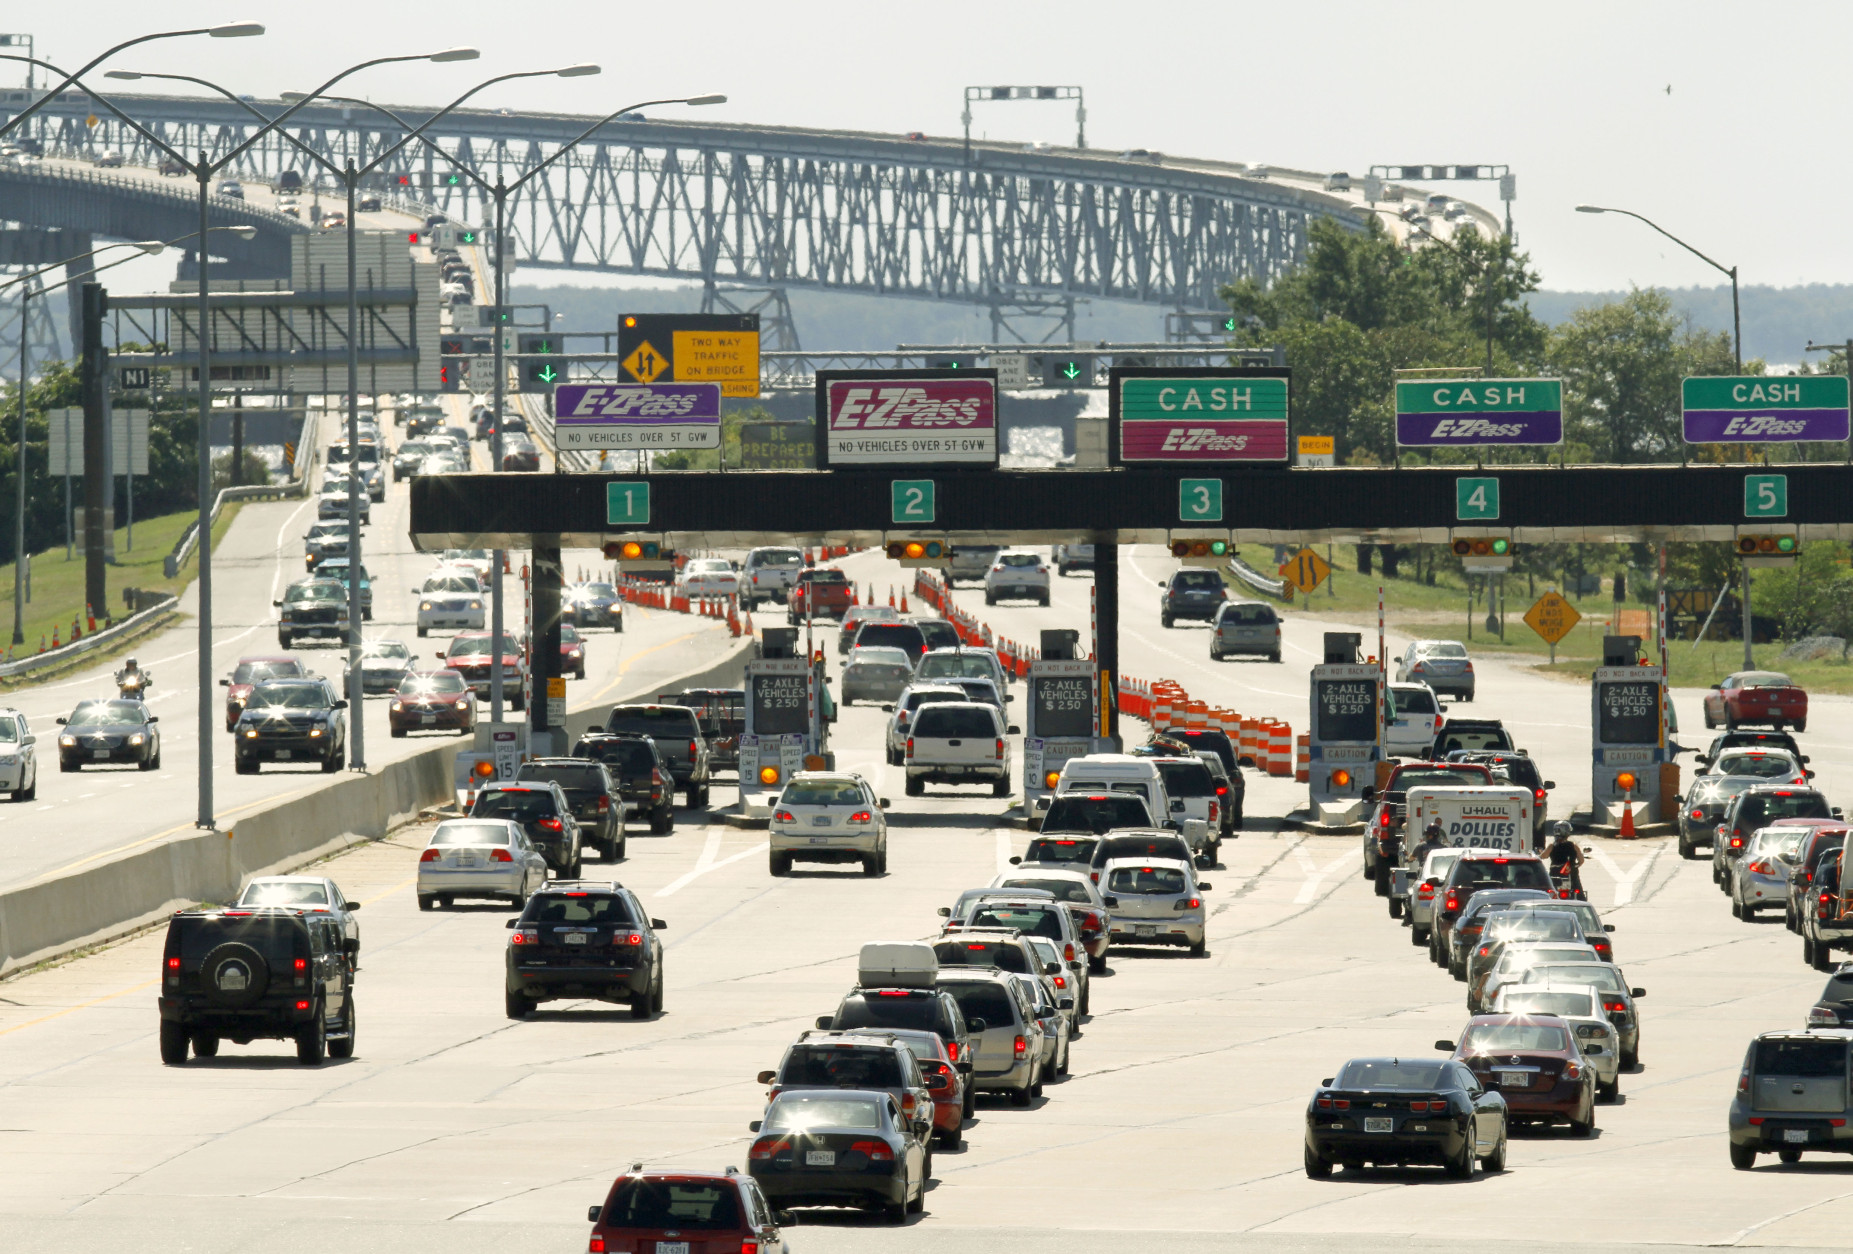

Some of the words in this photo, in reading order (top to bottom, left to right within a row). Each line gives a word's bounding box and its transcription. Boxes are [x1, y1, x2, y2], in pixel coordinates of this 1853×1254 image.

[691, 338, 712, 346] TWO
[719, 338, 741, 346] WAY
[694, 352, 738, 360] TRAFFIC
[687, 366, 701, 375] ON
[707, 365, 745, 375] BRIDGE
[721, 384, 754, 393] ASHING
[1732, 383, 1800, 402] CASH
[1158, 387, 1251, 411] CASH
[1433, 387, 1525, 406] CASH
[569, 433, 581, 443] NO
[588, 433, 633, 443] VEHICLES
[640, 432, 664, 442] OVER
[671, 432, 681, 442] 5T
[688, 432, 707, 442] GVW
[770, 426, 787, 441] BE
[743, 442, 814, 457] PREPARED
[839, 441, 853, 452] NO
[857, 441, 908, 452] VEHICLES
[912, 440, 940, 451] OVER
[944, 440, 957, 450] 5T
[962, 440, 985, 450] GVW
[904, 488, 924, 514] 2
[1191, 486, 1211, 514] 3
[1467, 485, 1487, 512] 4
[1758, 483, 1776, 510] 5
[624, 490, 633, 516] 1
[762, 678, 800, 688] 2-AXLE
[1043, 681, 1083, 690] 2-AXLE
[757, 688, 806, 698] VEHICLES
[1327, 684, 1366, 694] 2-AXLE
[1608, 686, 1648, 696] 2-AXLE
[1040, 690, 1088, 700] VEHICLES
[1322, 694, 1371, 704] VEHICLES
[776, 698, 799, 707] 2.50
[1058, 700, 1081, 710] 2.50
[1604, 696, 1653, 706] VEHICLES
[1340, 704, 1364, 714] 2.50
[1623, 706, 1647, 716] 2.50
[741, 748, 756, 757] SPEED
[782, 748, 800, 757] SPEED
[1046, 746, 1083, 754] CAUTION
[1328, 750, 1366, 759] CAUTION
[499, 754, 512, 762] LIMIT
[1026, 753, 1041, 761] SPEED
[1610, 752, 1648, 760] CAUTION
[499, 762, 513, 778] 15
[745, 769, 753, 780] 15
[1029, 773, 1037, 785] 10
[1462, 806, 1509, 815] U-HAUL
[1450, 822, 1516, 836] DOLLIES
[1453, 837, 1465, 848] &
[1469, 837, 1513, 850] PADS
